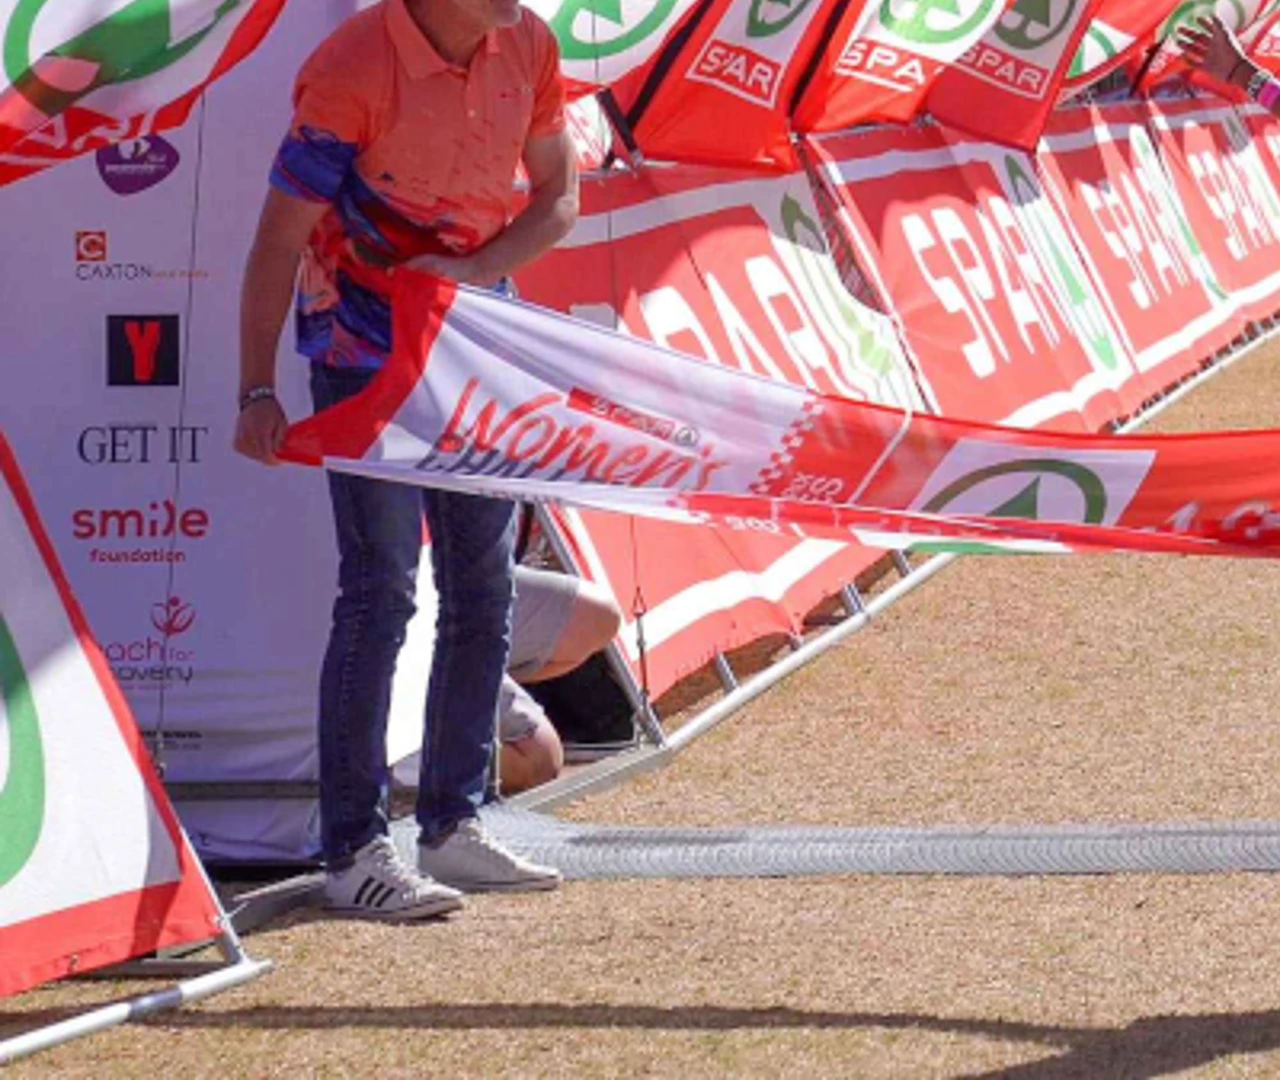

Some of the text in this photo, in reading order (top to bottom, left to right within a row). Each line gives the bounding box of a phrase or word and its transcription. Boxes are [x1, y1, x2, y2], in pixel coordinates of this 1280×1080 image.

[843, 41, 925, 89] SPA
[76, 264, 151, 281] CAXTON
[898, 205, 1072, 380] SPAR
[123, 321, 161, 383] Y
[77, 426, 208, 465] GET IT
[89, 548, 185, 562] foundation
[105, 636, 165, 661] ach
[117, 665, 193, 686] overy
